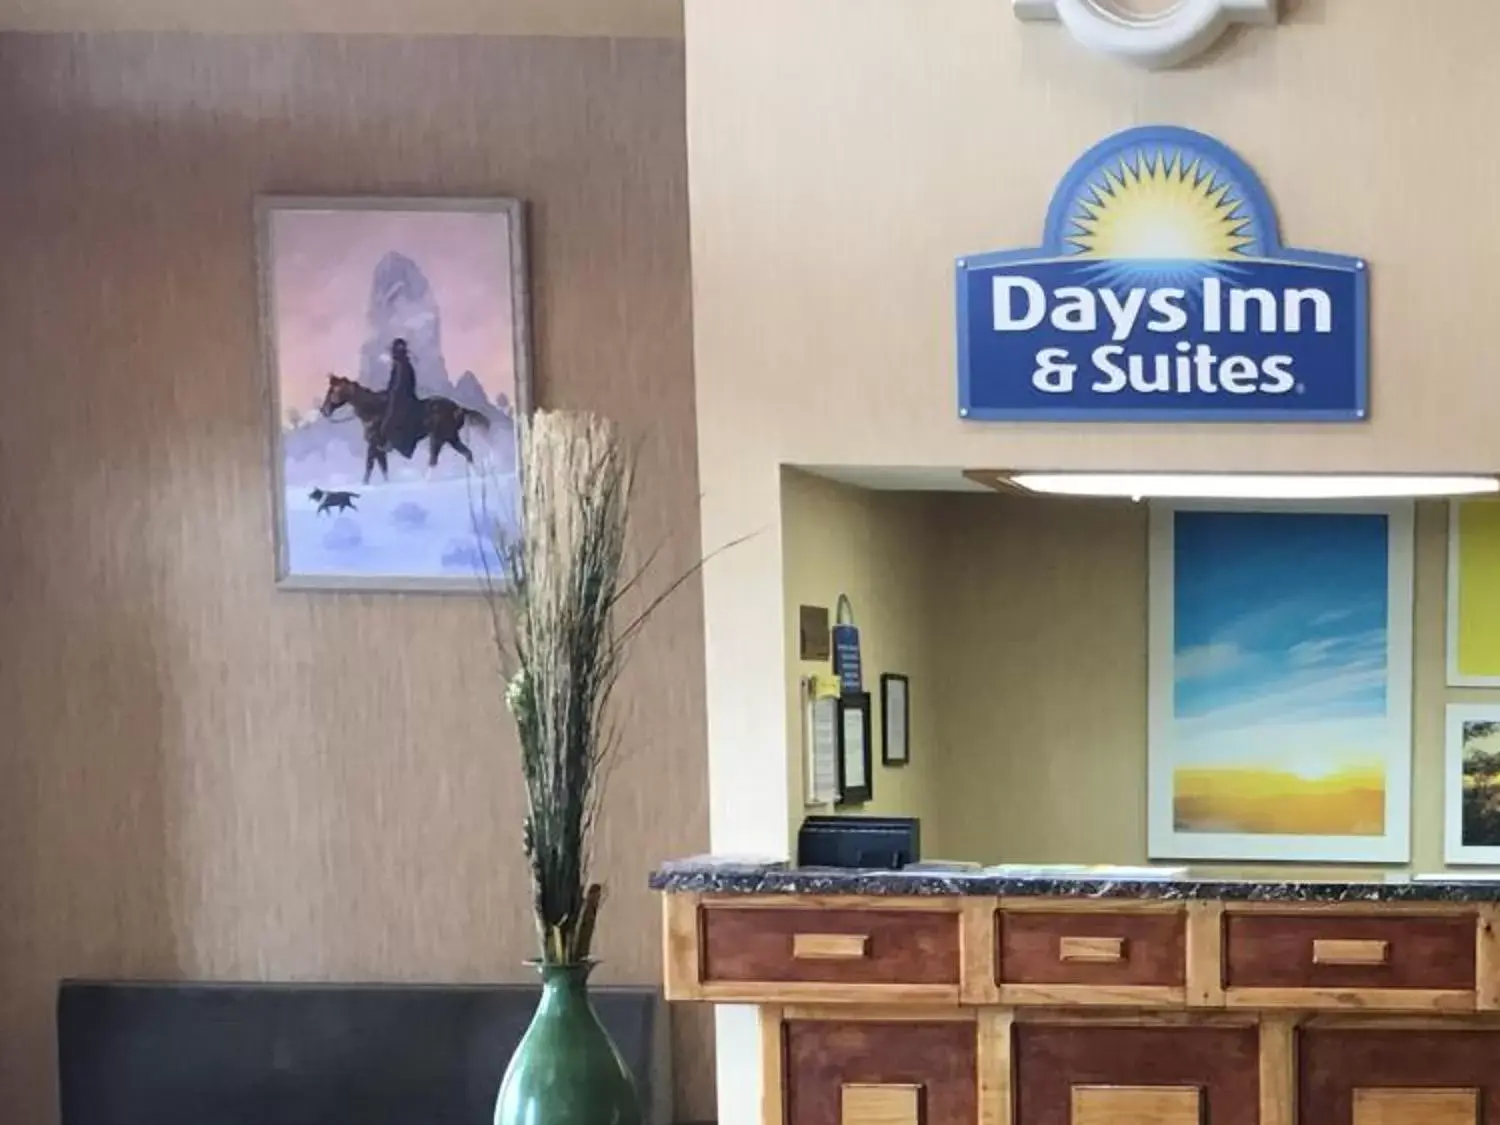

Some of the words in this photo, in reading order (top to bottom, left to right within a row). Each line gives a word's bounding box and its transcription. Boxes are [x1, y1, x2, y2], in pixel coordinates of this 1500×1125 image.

[991, 275, 1187, 341] Days
[1202, 276, 1332, 333] Inn
[1031, 347, 1078, 394] &
[1091, 340, 1295, 395] Suites
